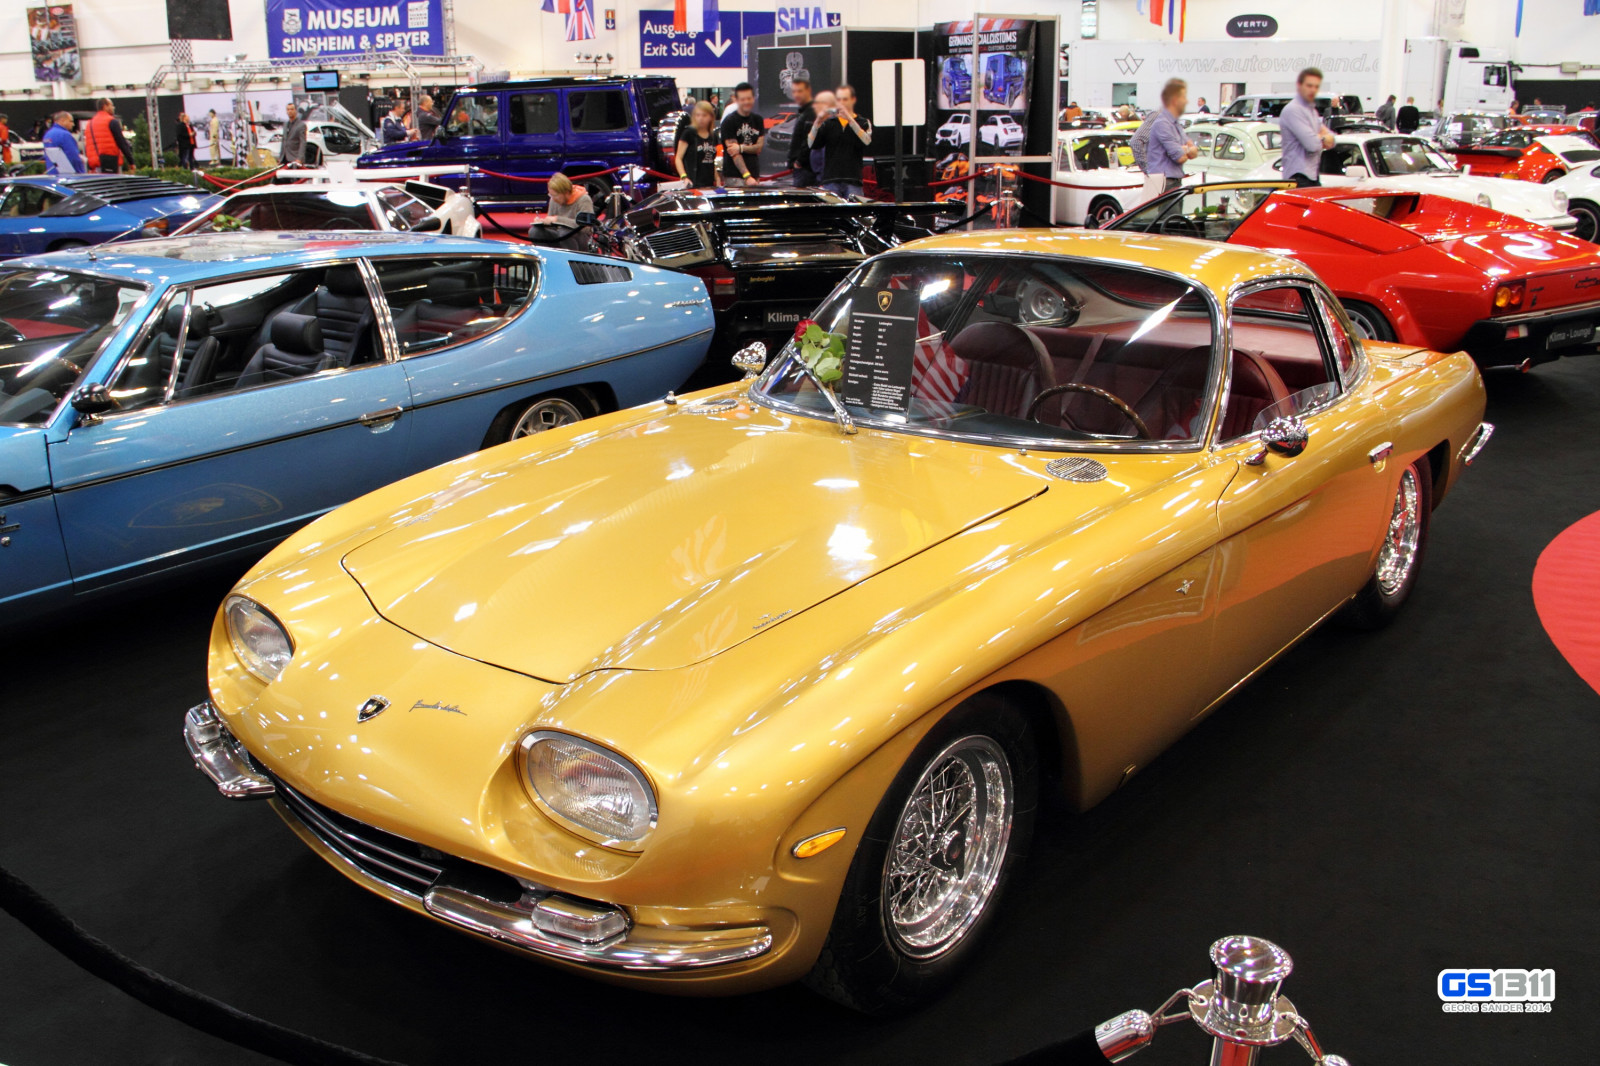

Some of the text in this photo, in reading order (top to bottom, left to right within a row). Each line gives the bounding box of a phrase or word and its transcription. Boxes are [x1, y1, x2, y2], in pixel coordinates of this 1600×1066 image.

[307, 6, 400, 31] MUSEUM
[777, 7, 823, 32] SiHA
[1236, 20, 1268, 28] VERTU
[643, 20, 699, 39] Ausgg
[281, 31, 430, 53] SINSHEIM & SPEYER
[643, 42, 696, 57] Exit Süd
[767, 312, 800, 323] Klima
[1549, 332, 1566, 342] Klima
